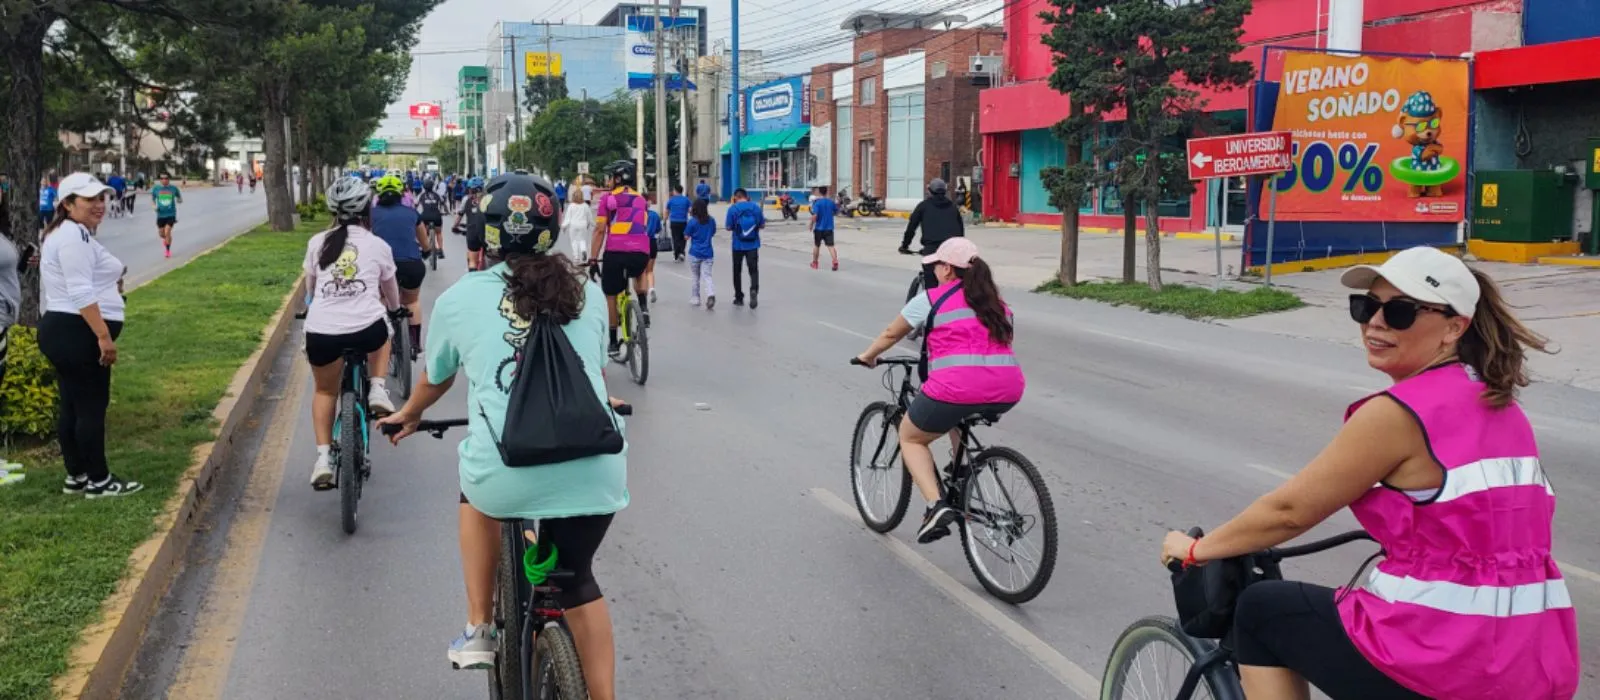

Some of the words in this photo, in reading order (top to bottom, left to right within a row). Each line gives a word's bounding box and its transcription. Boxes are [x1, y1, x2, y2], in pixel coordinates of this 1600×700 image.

[1285, 62, 1368, 95] VERANO
[1307, 88, 1400, 122] SOÑADO
[1352, 131, 1367, 139] con
